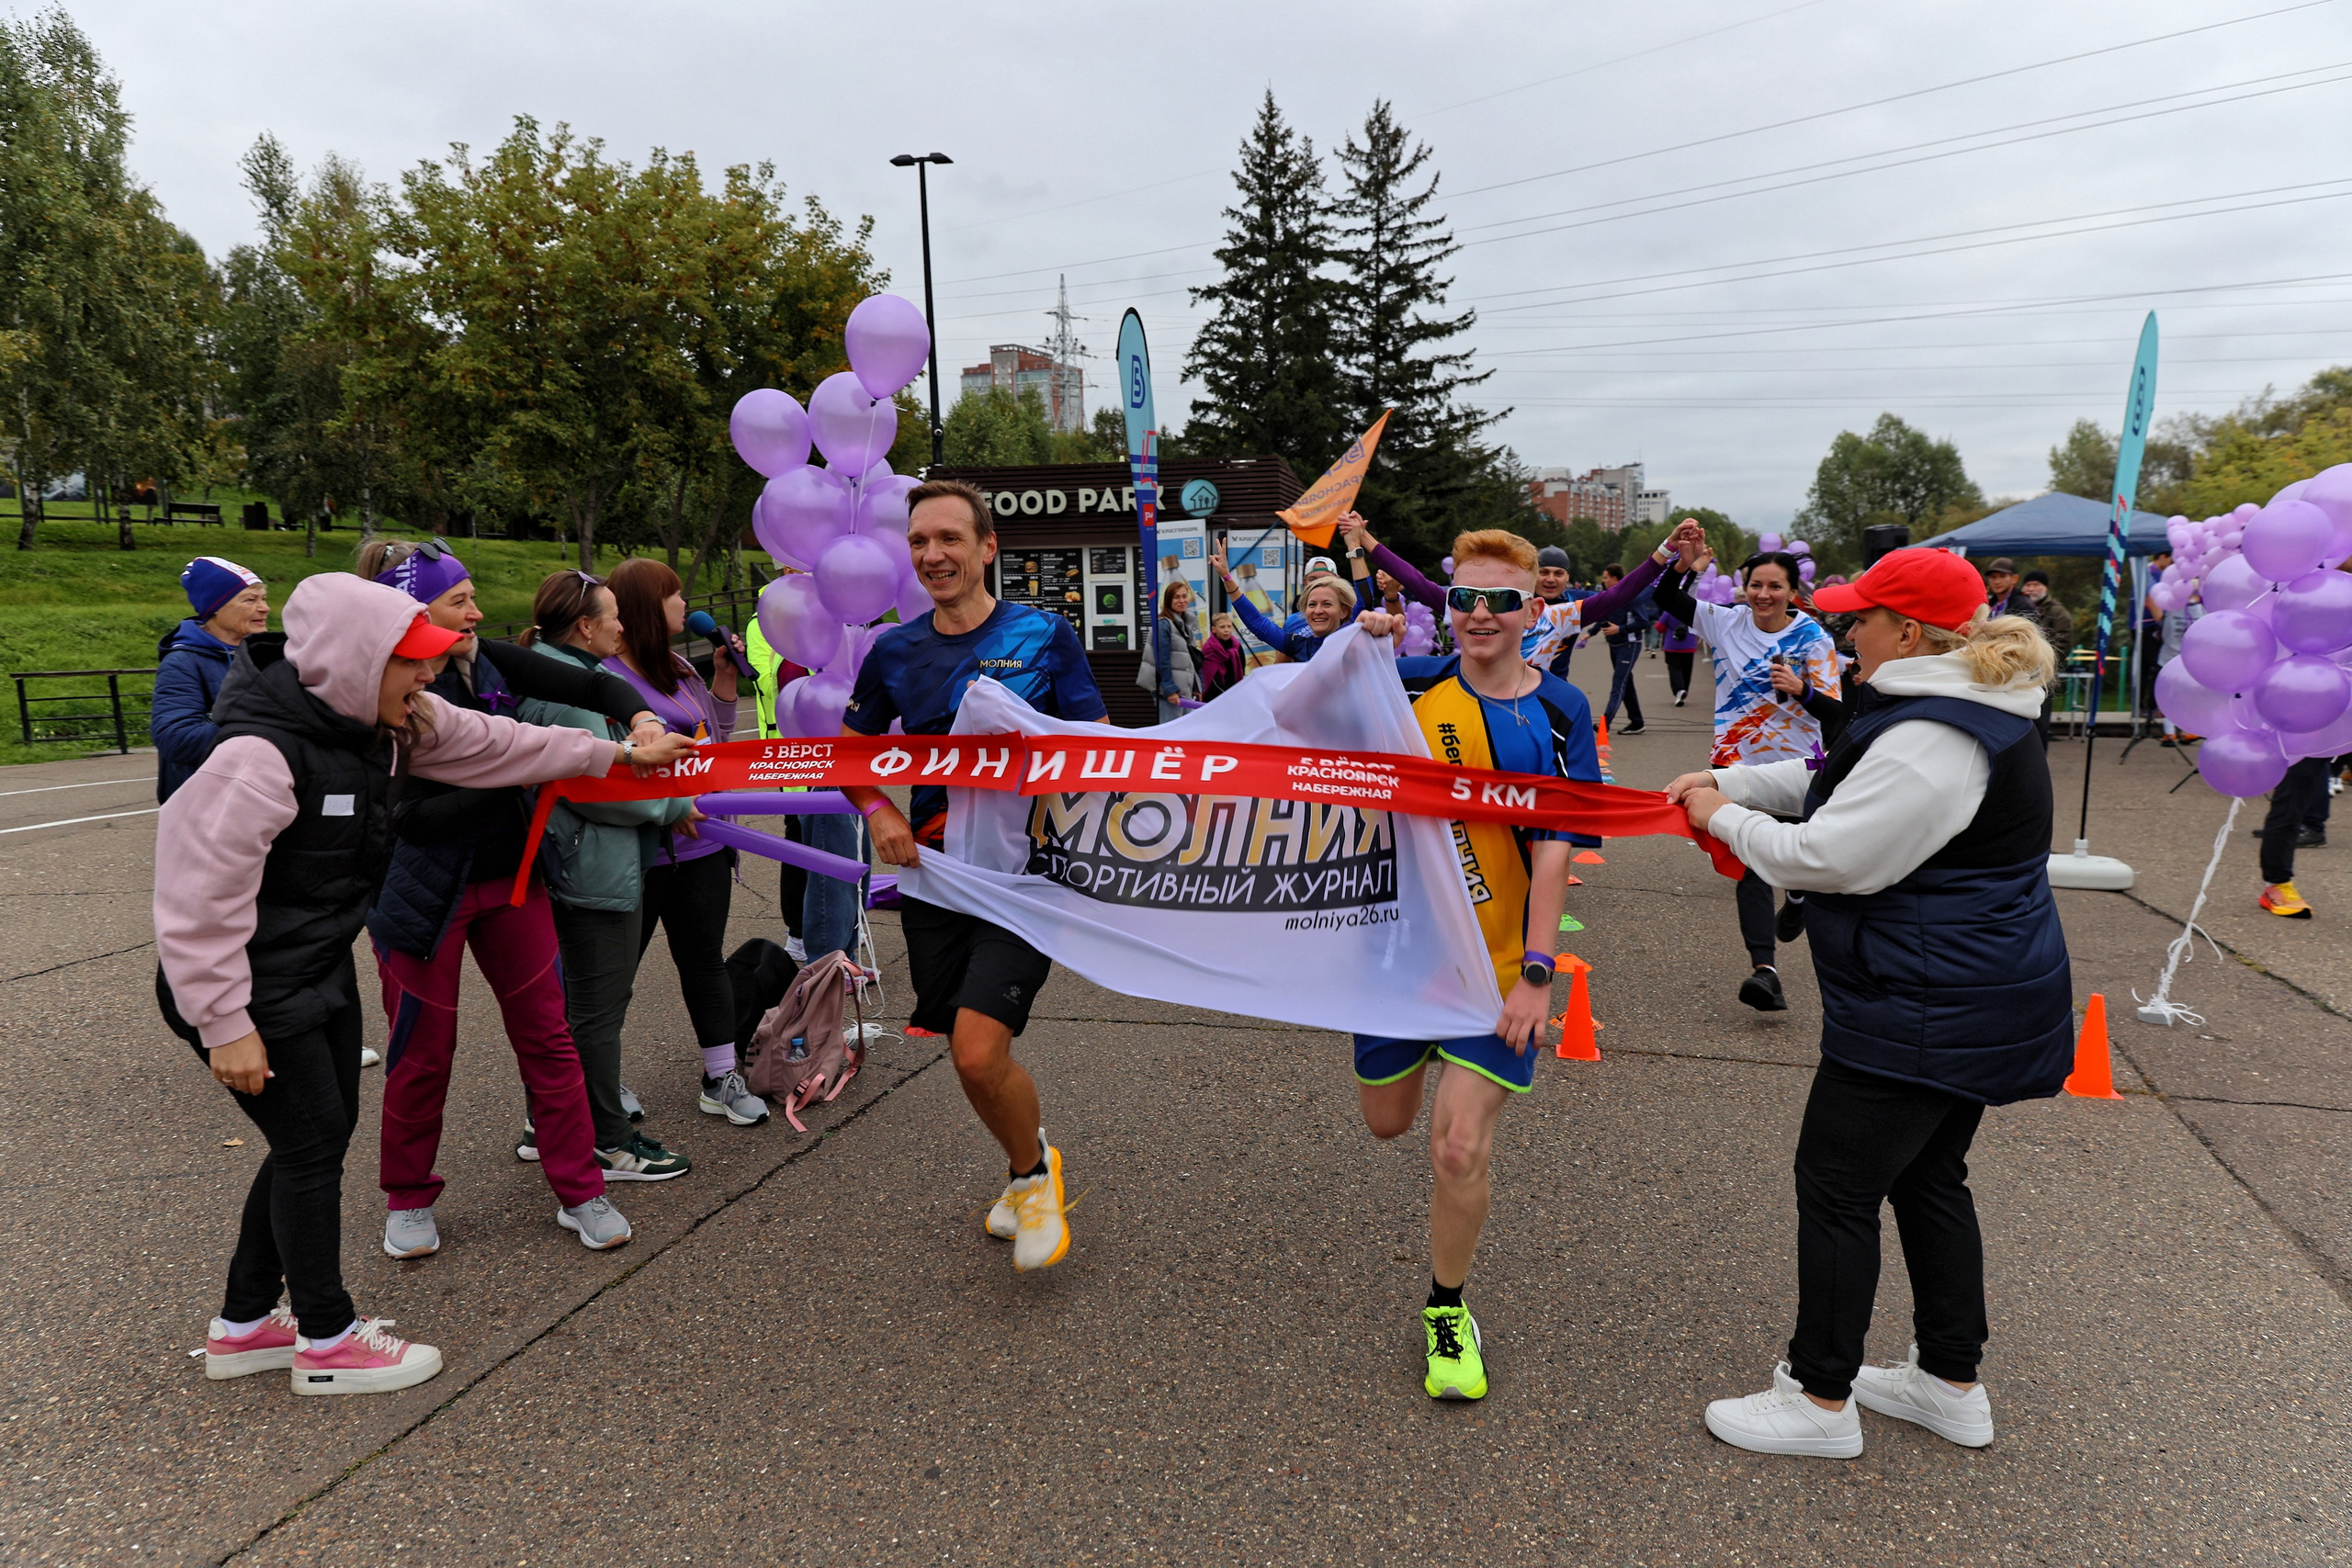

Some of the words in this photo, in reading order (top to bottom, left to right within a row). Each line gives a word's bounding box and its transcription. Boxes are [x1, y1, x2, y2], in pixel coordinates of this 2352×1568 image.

[1078, 486, 1166, 513] PARK
[979, 659, 1023, 669] МОЛНИЯ
[762, 745, 774, 759] 5
[777, 742, 833, 759] ВЁРСТ
[674, 756, 715, 778] КМ
[748, 760, 836, 771] КРАСНОЯРСК
[748, 772, 825, 781] НАБЕРЕЖНАЯ
[1287, 764, 1400, 789] КРАСНОЯРСК
[1292, 781, 1393, 799] НАБЕРЕЖНАЯ
[1450, 776, 1472, 800] 5
[1481, 781, 1538, 810] КМ
[1029, 792, 1396, 868] МОЛНИЯ
[1025, 852, 1257, 905] СПОРТИВНЫЙ
[1264, 860, 1394, 905] ЖУРНАЛ
[1284, 905, 1399, 932] molniya26.ru
